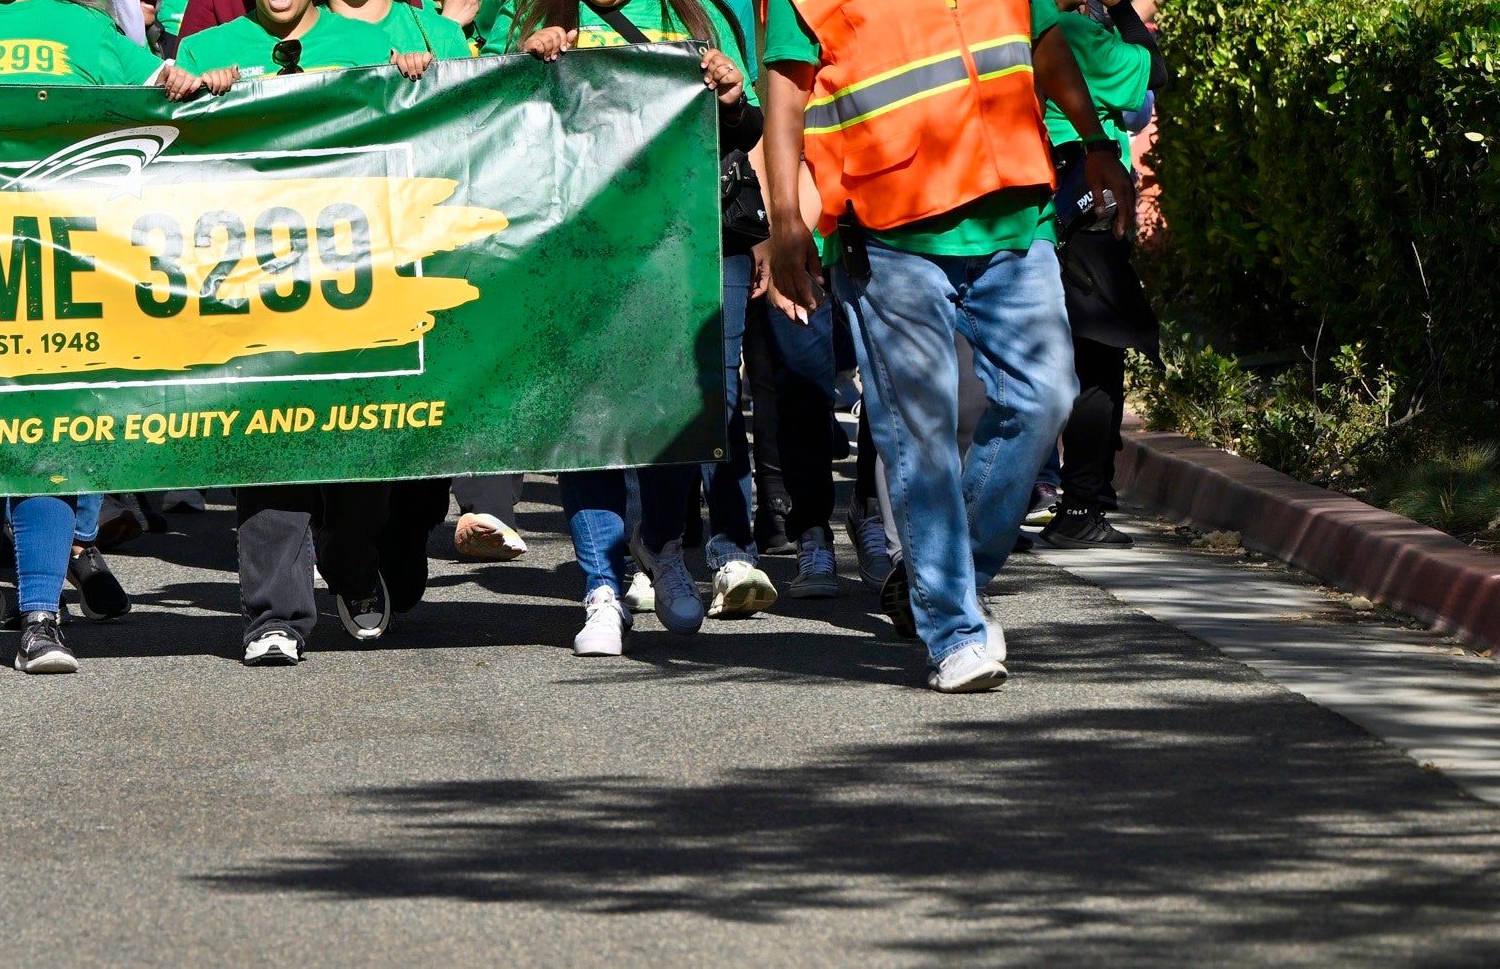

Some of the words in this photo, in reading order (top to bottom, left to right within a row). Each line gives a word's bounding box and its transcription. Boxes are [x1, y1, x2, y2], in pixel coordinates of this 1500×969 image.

[129, 202, 374, 320] 3299
[40, 332, 100, 354] 1948
[52, 415, 115, 443] FOR
[124, 411, 240, 444] EQUITY
[244, 407, 316, 435] AND
[321, 401, 445, 431] JUSTICE
